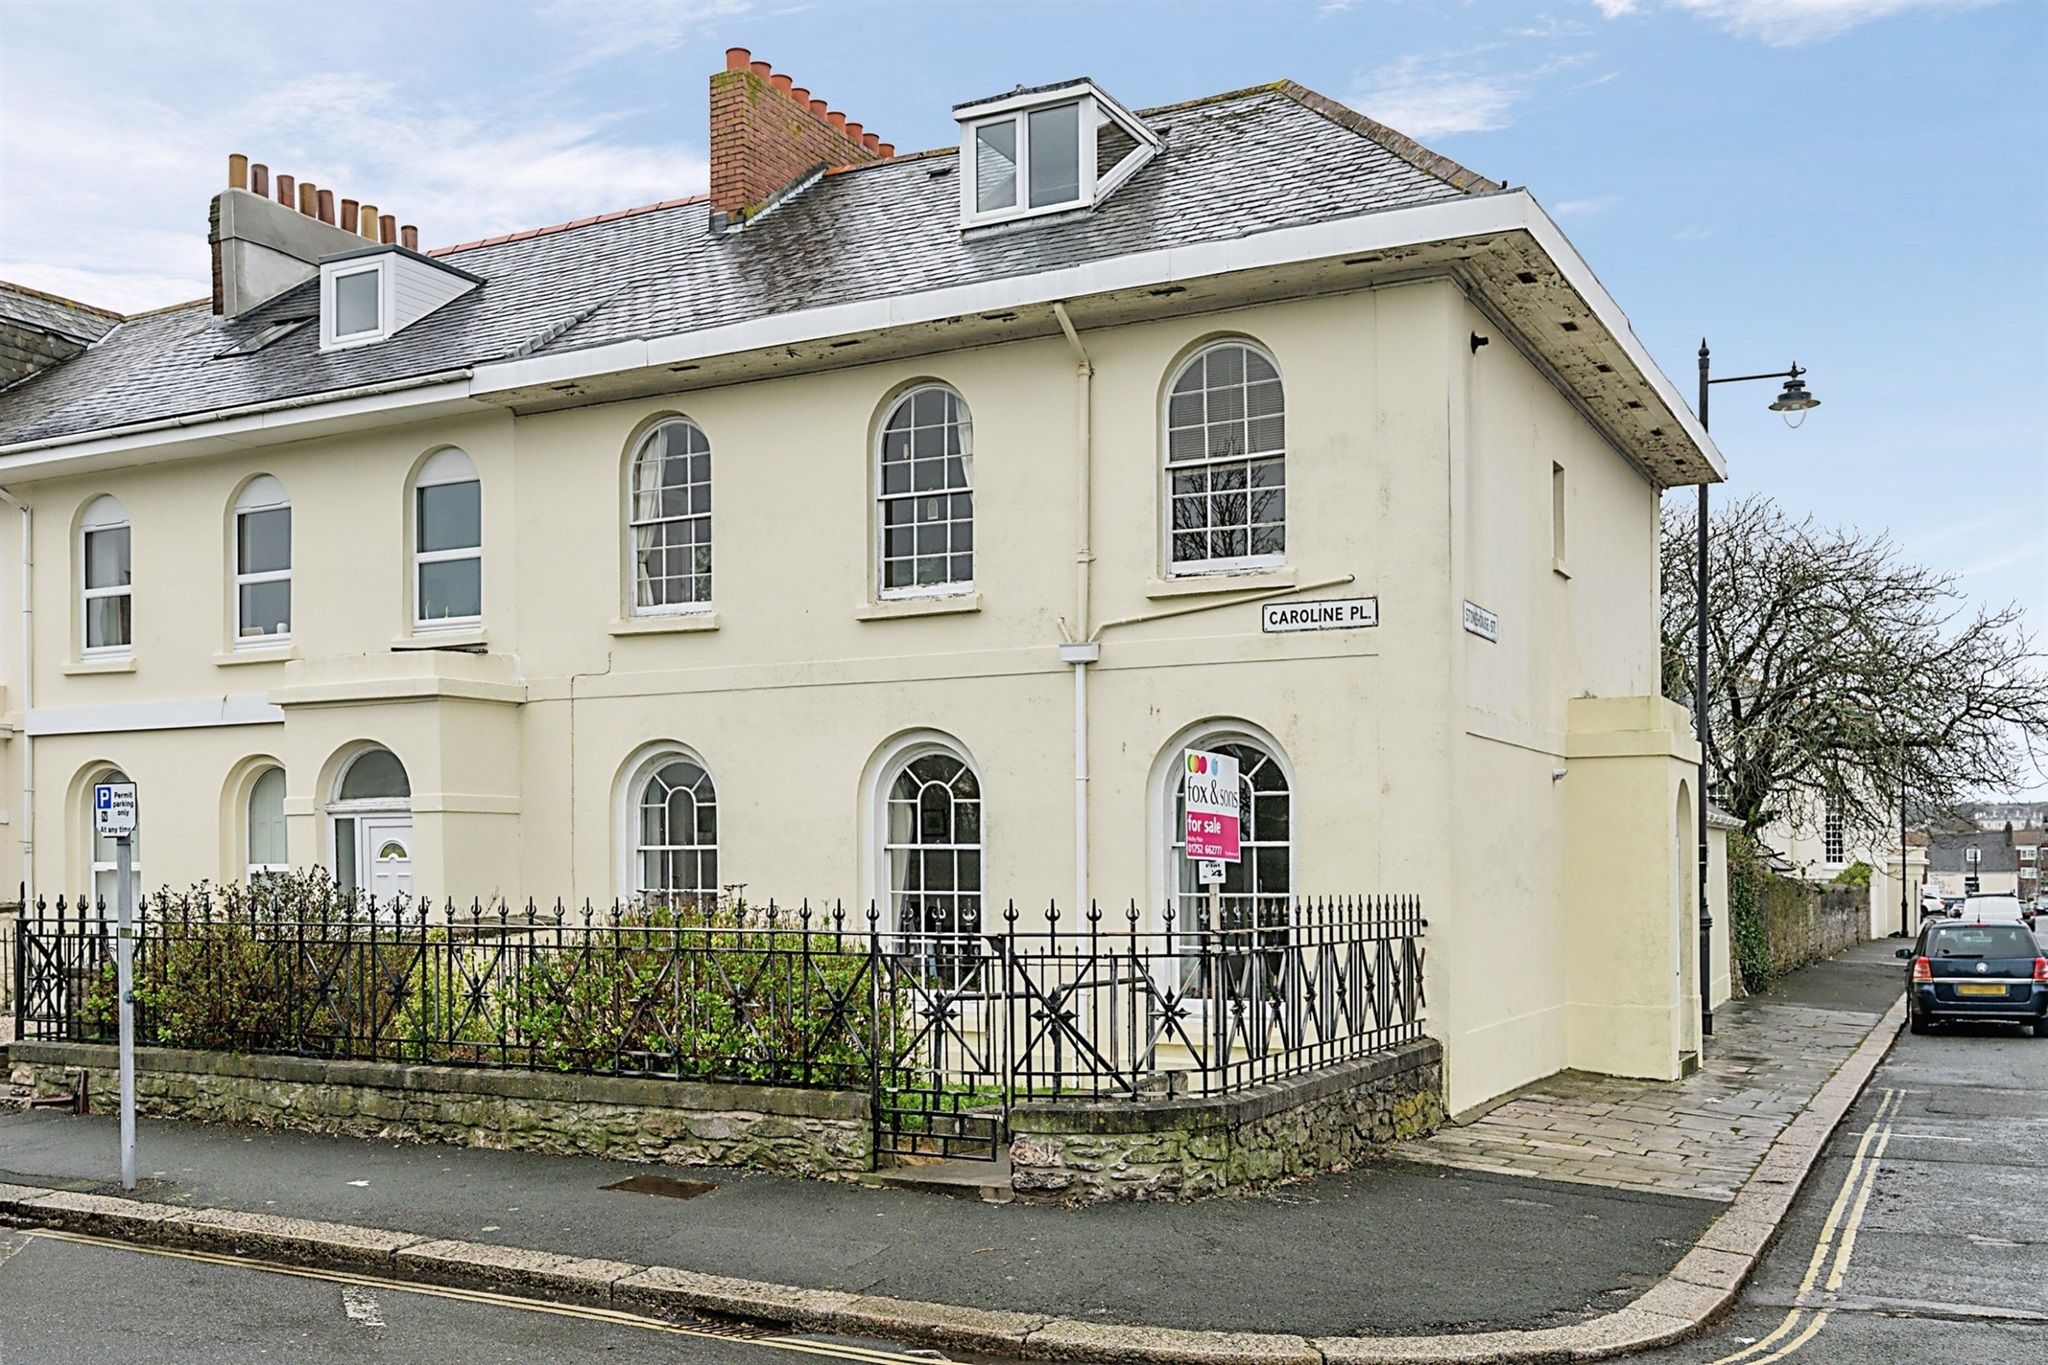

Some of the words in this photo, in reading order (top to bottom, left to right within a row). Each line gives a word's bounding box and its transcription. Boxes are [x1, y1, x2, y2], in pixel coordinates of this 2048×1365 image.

[1269, 607, 1343, 625] CAROLINE
[1350, 605, 1372, 620] PL.
[114, 791, 133, 799] Permit
[1187, 776, 1208, 804] fox
[1210, 779, 1219, 805] &
[1220, 788, 1239, 809] sons
[113, 800, 133, 808] parking
[1187, 814, 1202, 832] for
[1204, 816, 1221, 834] sale
